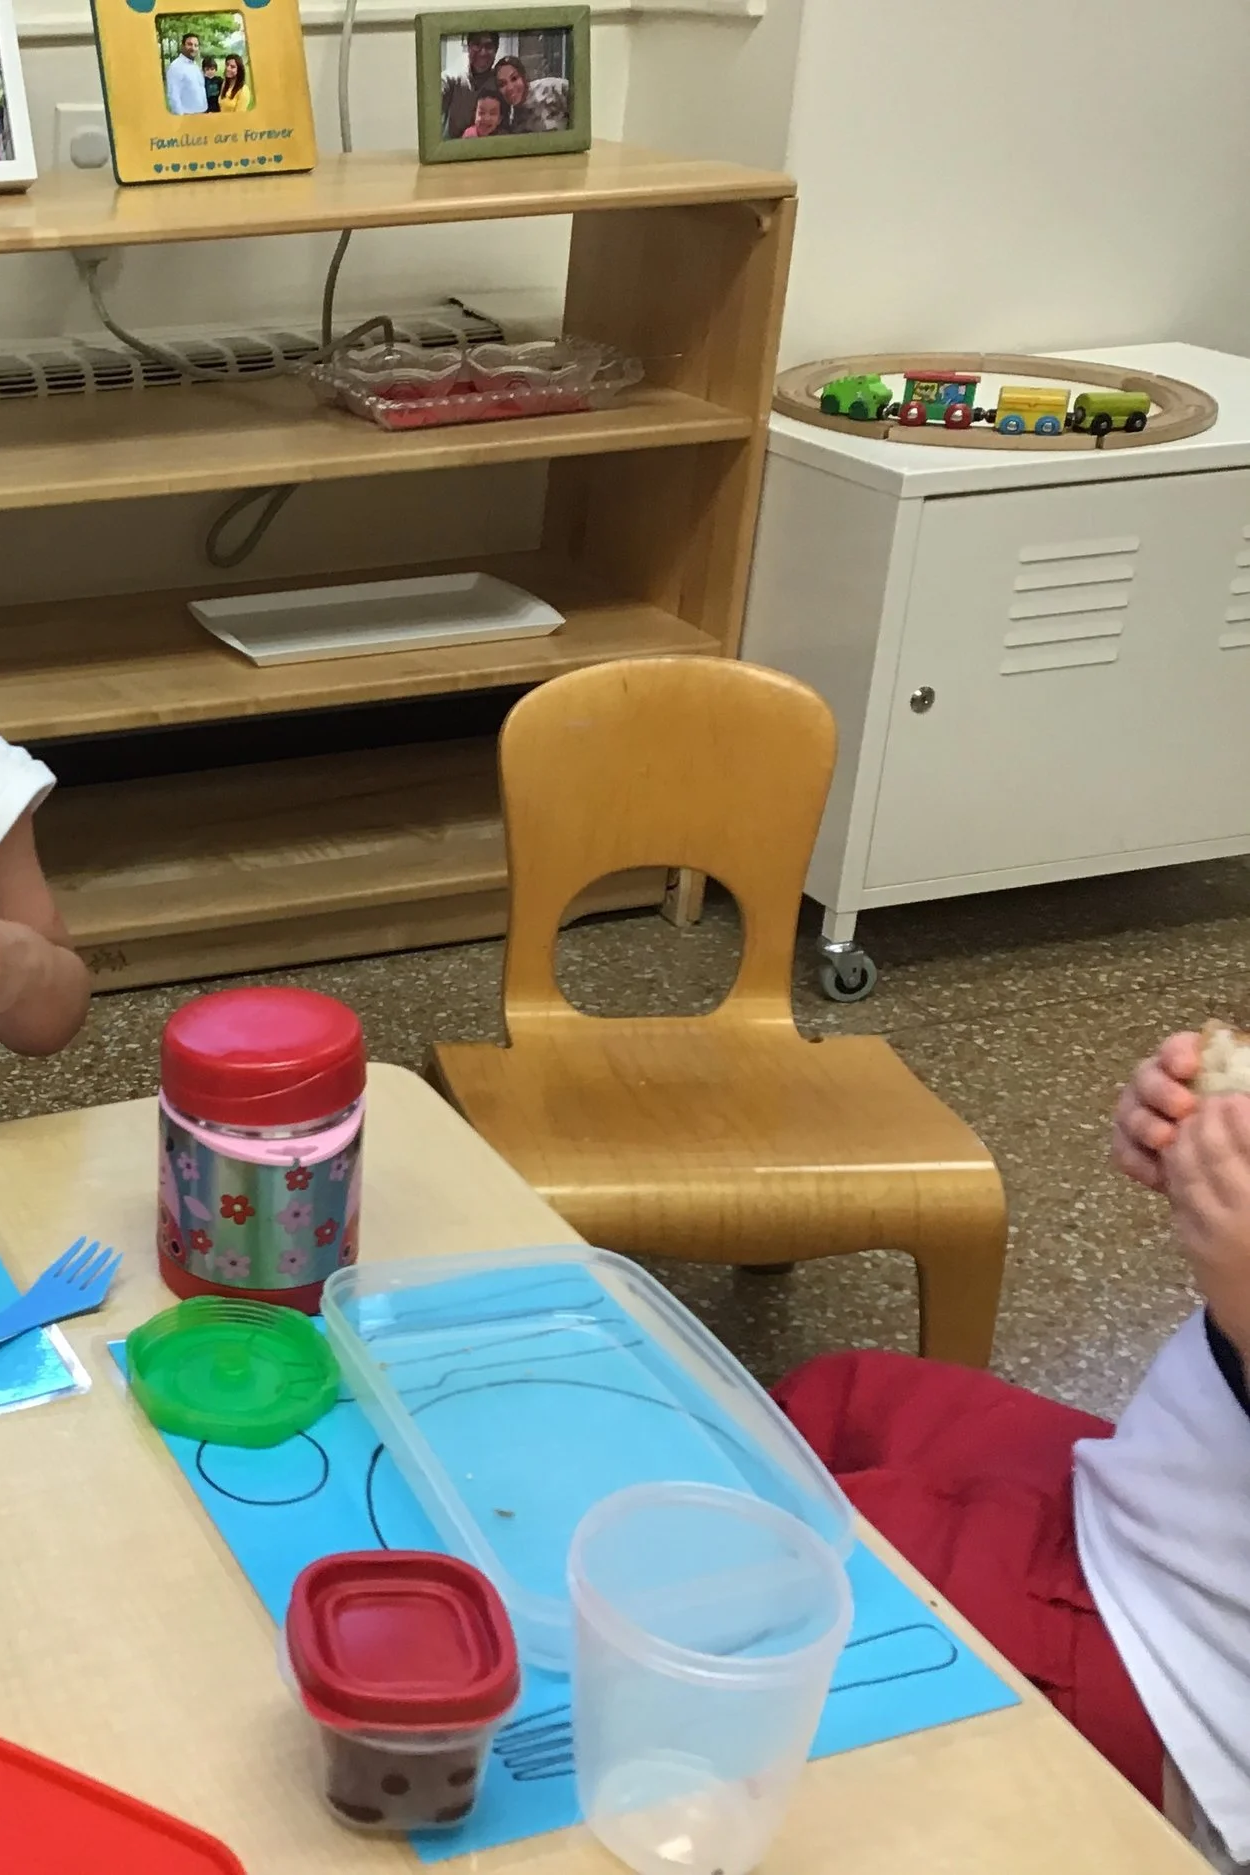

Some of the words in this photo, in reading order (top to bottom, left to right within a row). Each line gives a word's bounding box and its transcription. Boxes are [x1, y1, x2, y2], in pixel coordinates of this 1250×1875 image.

[149, 133, 208, 151] Families
[214, 133, 238, 145] are
[244, 128, 294, 143] Forever
